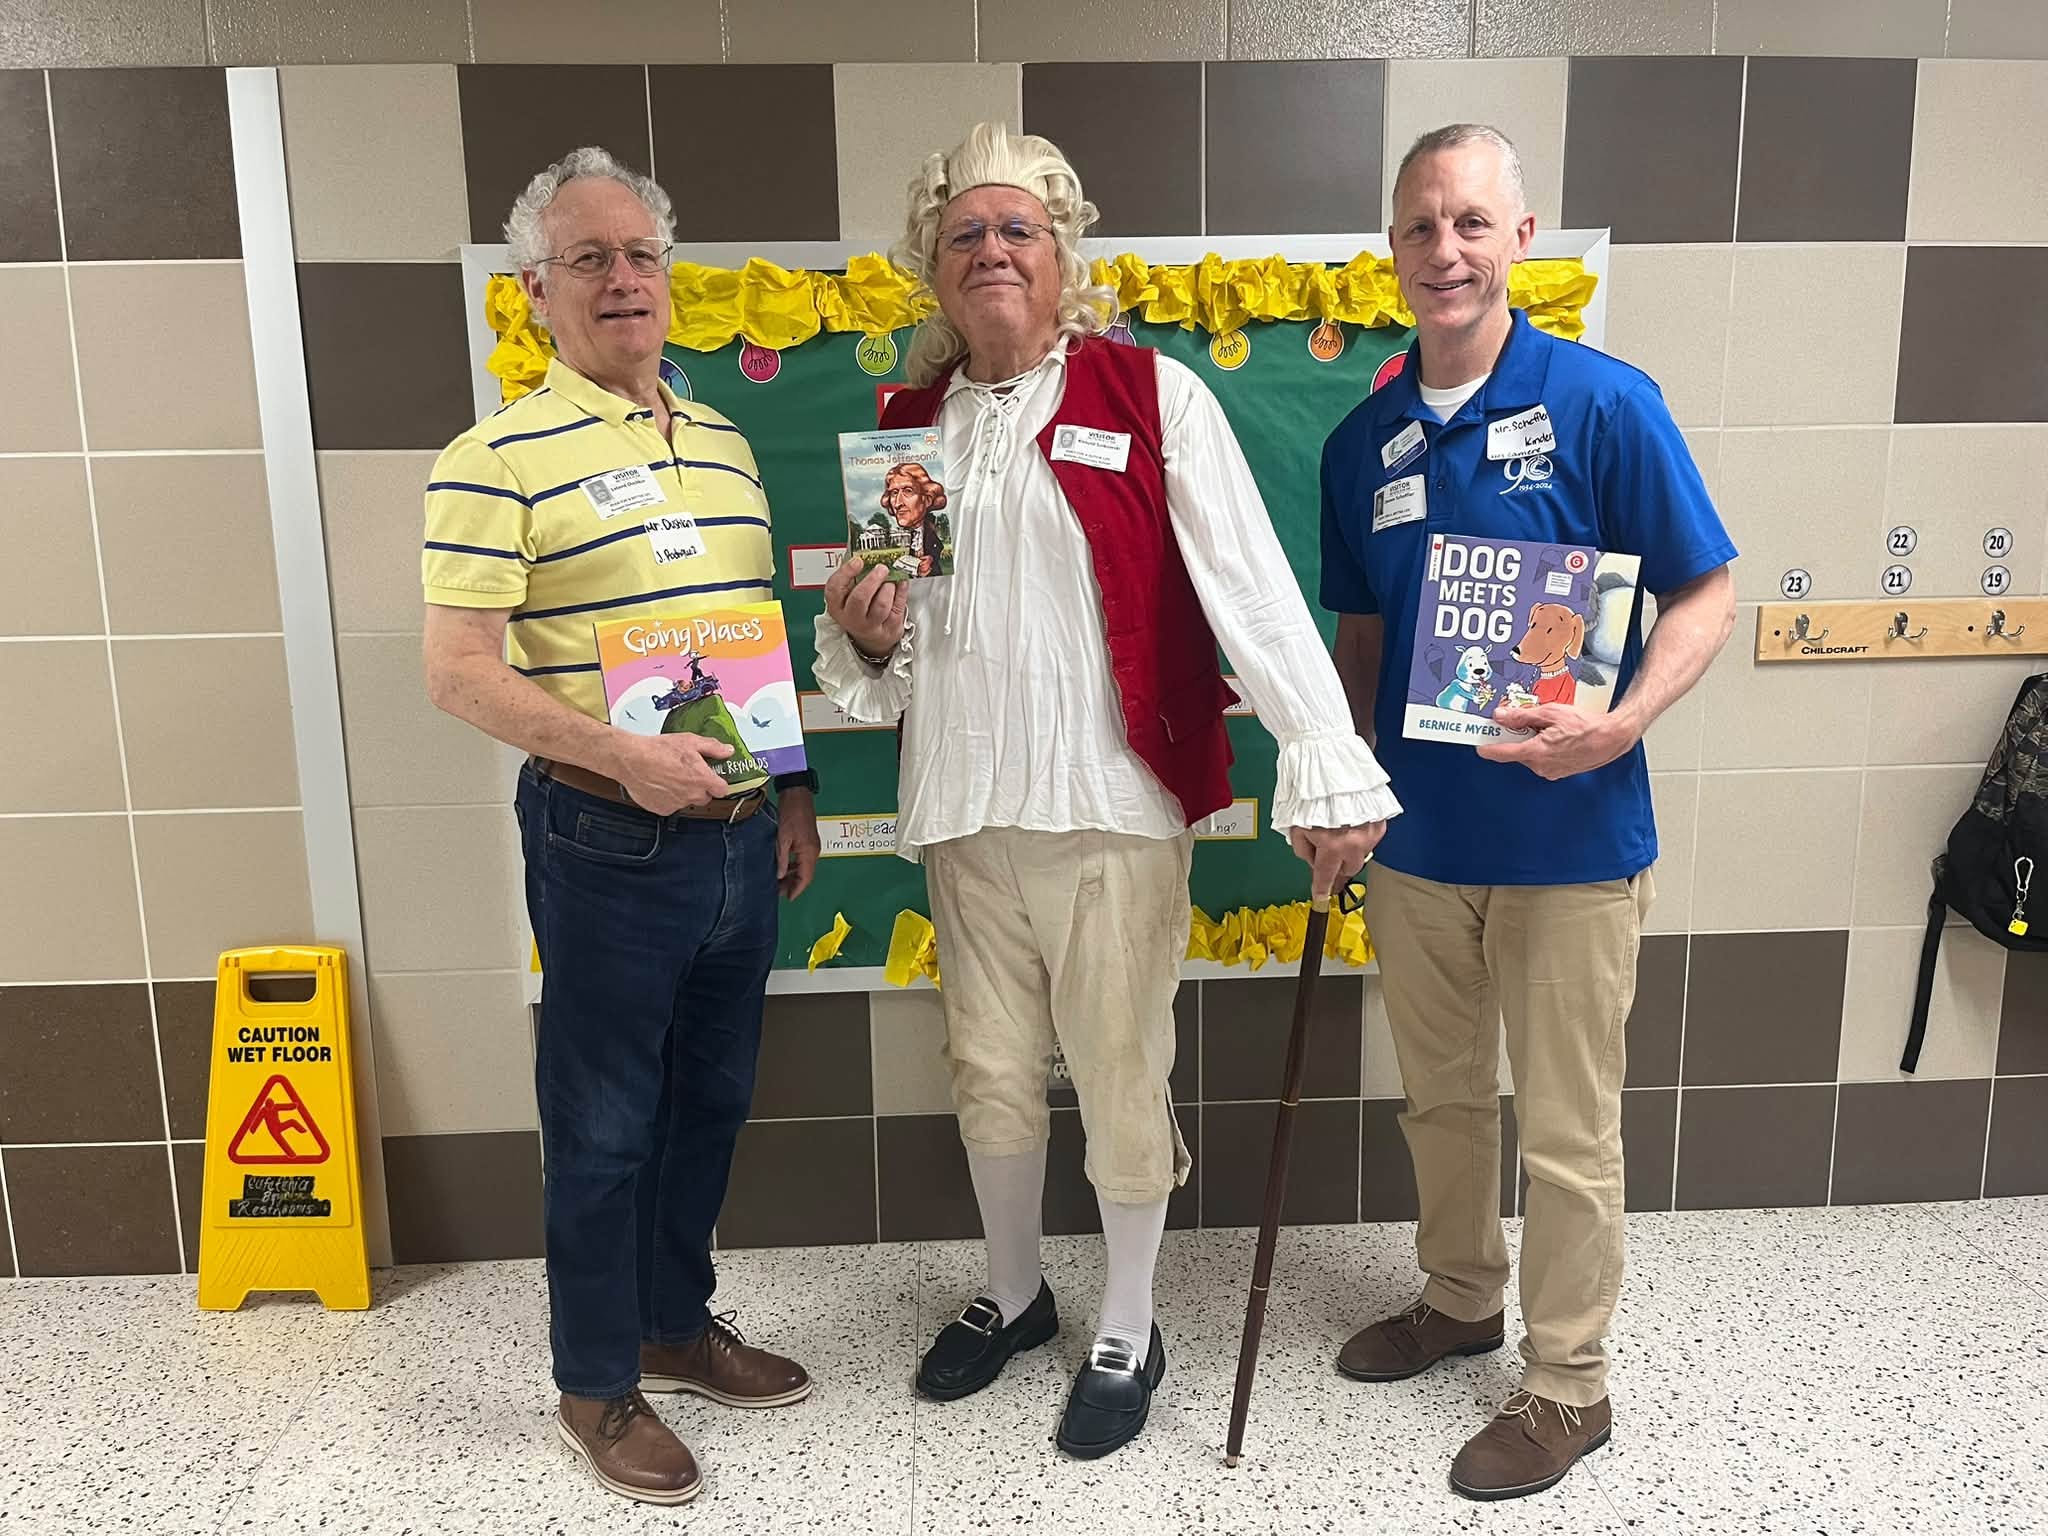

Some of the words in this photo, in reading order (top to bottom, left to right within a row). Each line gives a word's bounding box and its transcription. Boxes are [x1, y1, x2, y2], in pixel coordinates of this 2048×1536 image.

[873, 443, 892, 452] Who
[893, 442, 912, 451] Was
[1524, 432, 1553, 447] Kinder
[848, 455, 885, 466] Thomas
[886, 450, 938, 464] Jefferson?
[612, 469, 638, 480] VISITOR
[645, 521, 664, 533] Mr.
[1893, 533, 1908, 549] 22
[1989, 534, 2004, 550] 20
[1442, 542, 1522, 582] DOG
[1786, 575, 1803, 593] 23
[1888, 571, 1903, 588] 21
[1987, 571, 2002, 588] 19
[1438, 579, 1517, 607] MEETS
[1434, 603, 1514, 643] DOG
[623, 621, 691, 657] Going
[692, 617, 763, 647] Places
[1418, 718, 1462, 733] BERNICE
[1465, 722, 1501, 737] MYERS
[726, 757, 769, 774] REYNOLDS
[826, 839, 844, 849] I'm
[847, 839, 866, 849] not
[238, 1026, 320, 1044] CAUTION
[227, 1046, 267, 1063] WET
[272, 1045, 332, 1063] FLOOR
